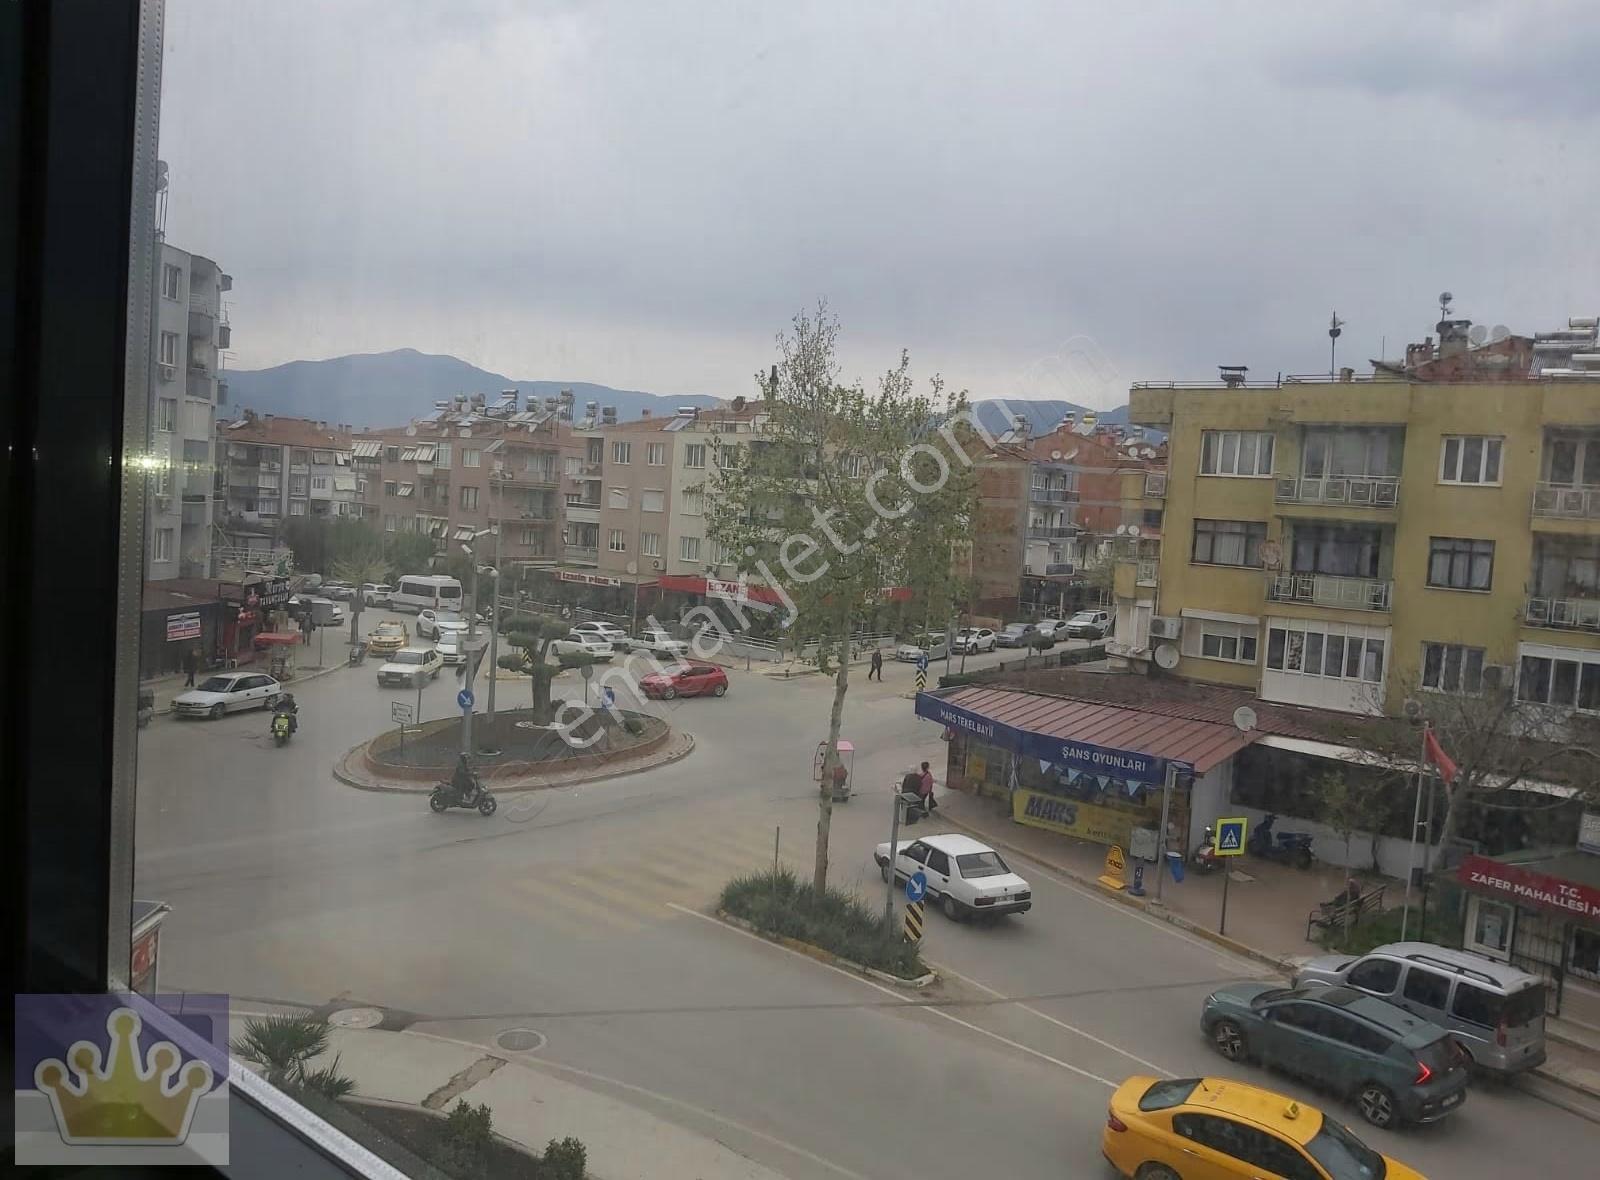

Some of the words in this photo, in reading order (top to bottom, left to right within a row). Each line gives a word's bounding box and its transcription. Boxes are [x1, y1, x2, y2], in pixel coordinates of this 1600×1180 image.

[957, 715, 976, 731] TEKEL
[1062, 746, 1090, 760] ŞANS
[1092, 752, 1146, 772] OYUNLARI
[1471, 872, 1511, 890] ZAFER
[1513, 884, 1590, 913] MAHALLESİ
[1559, 885, 1581, 899] T.C.
